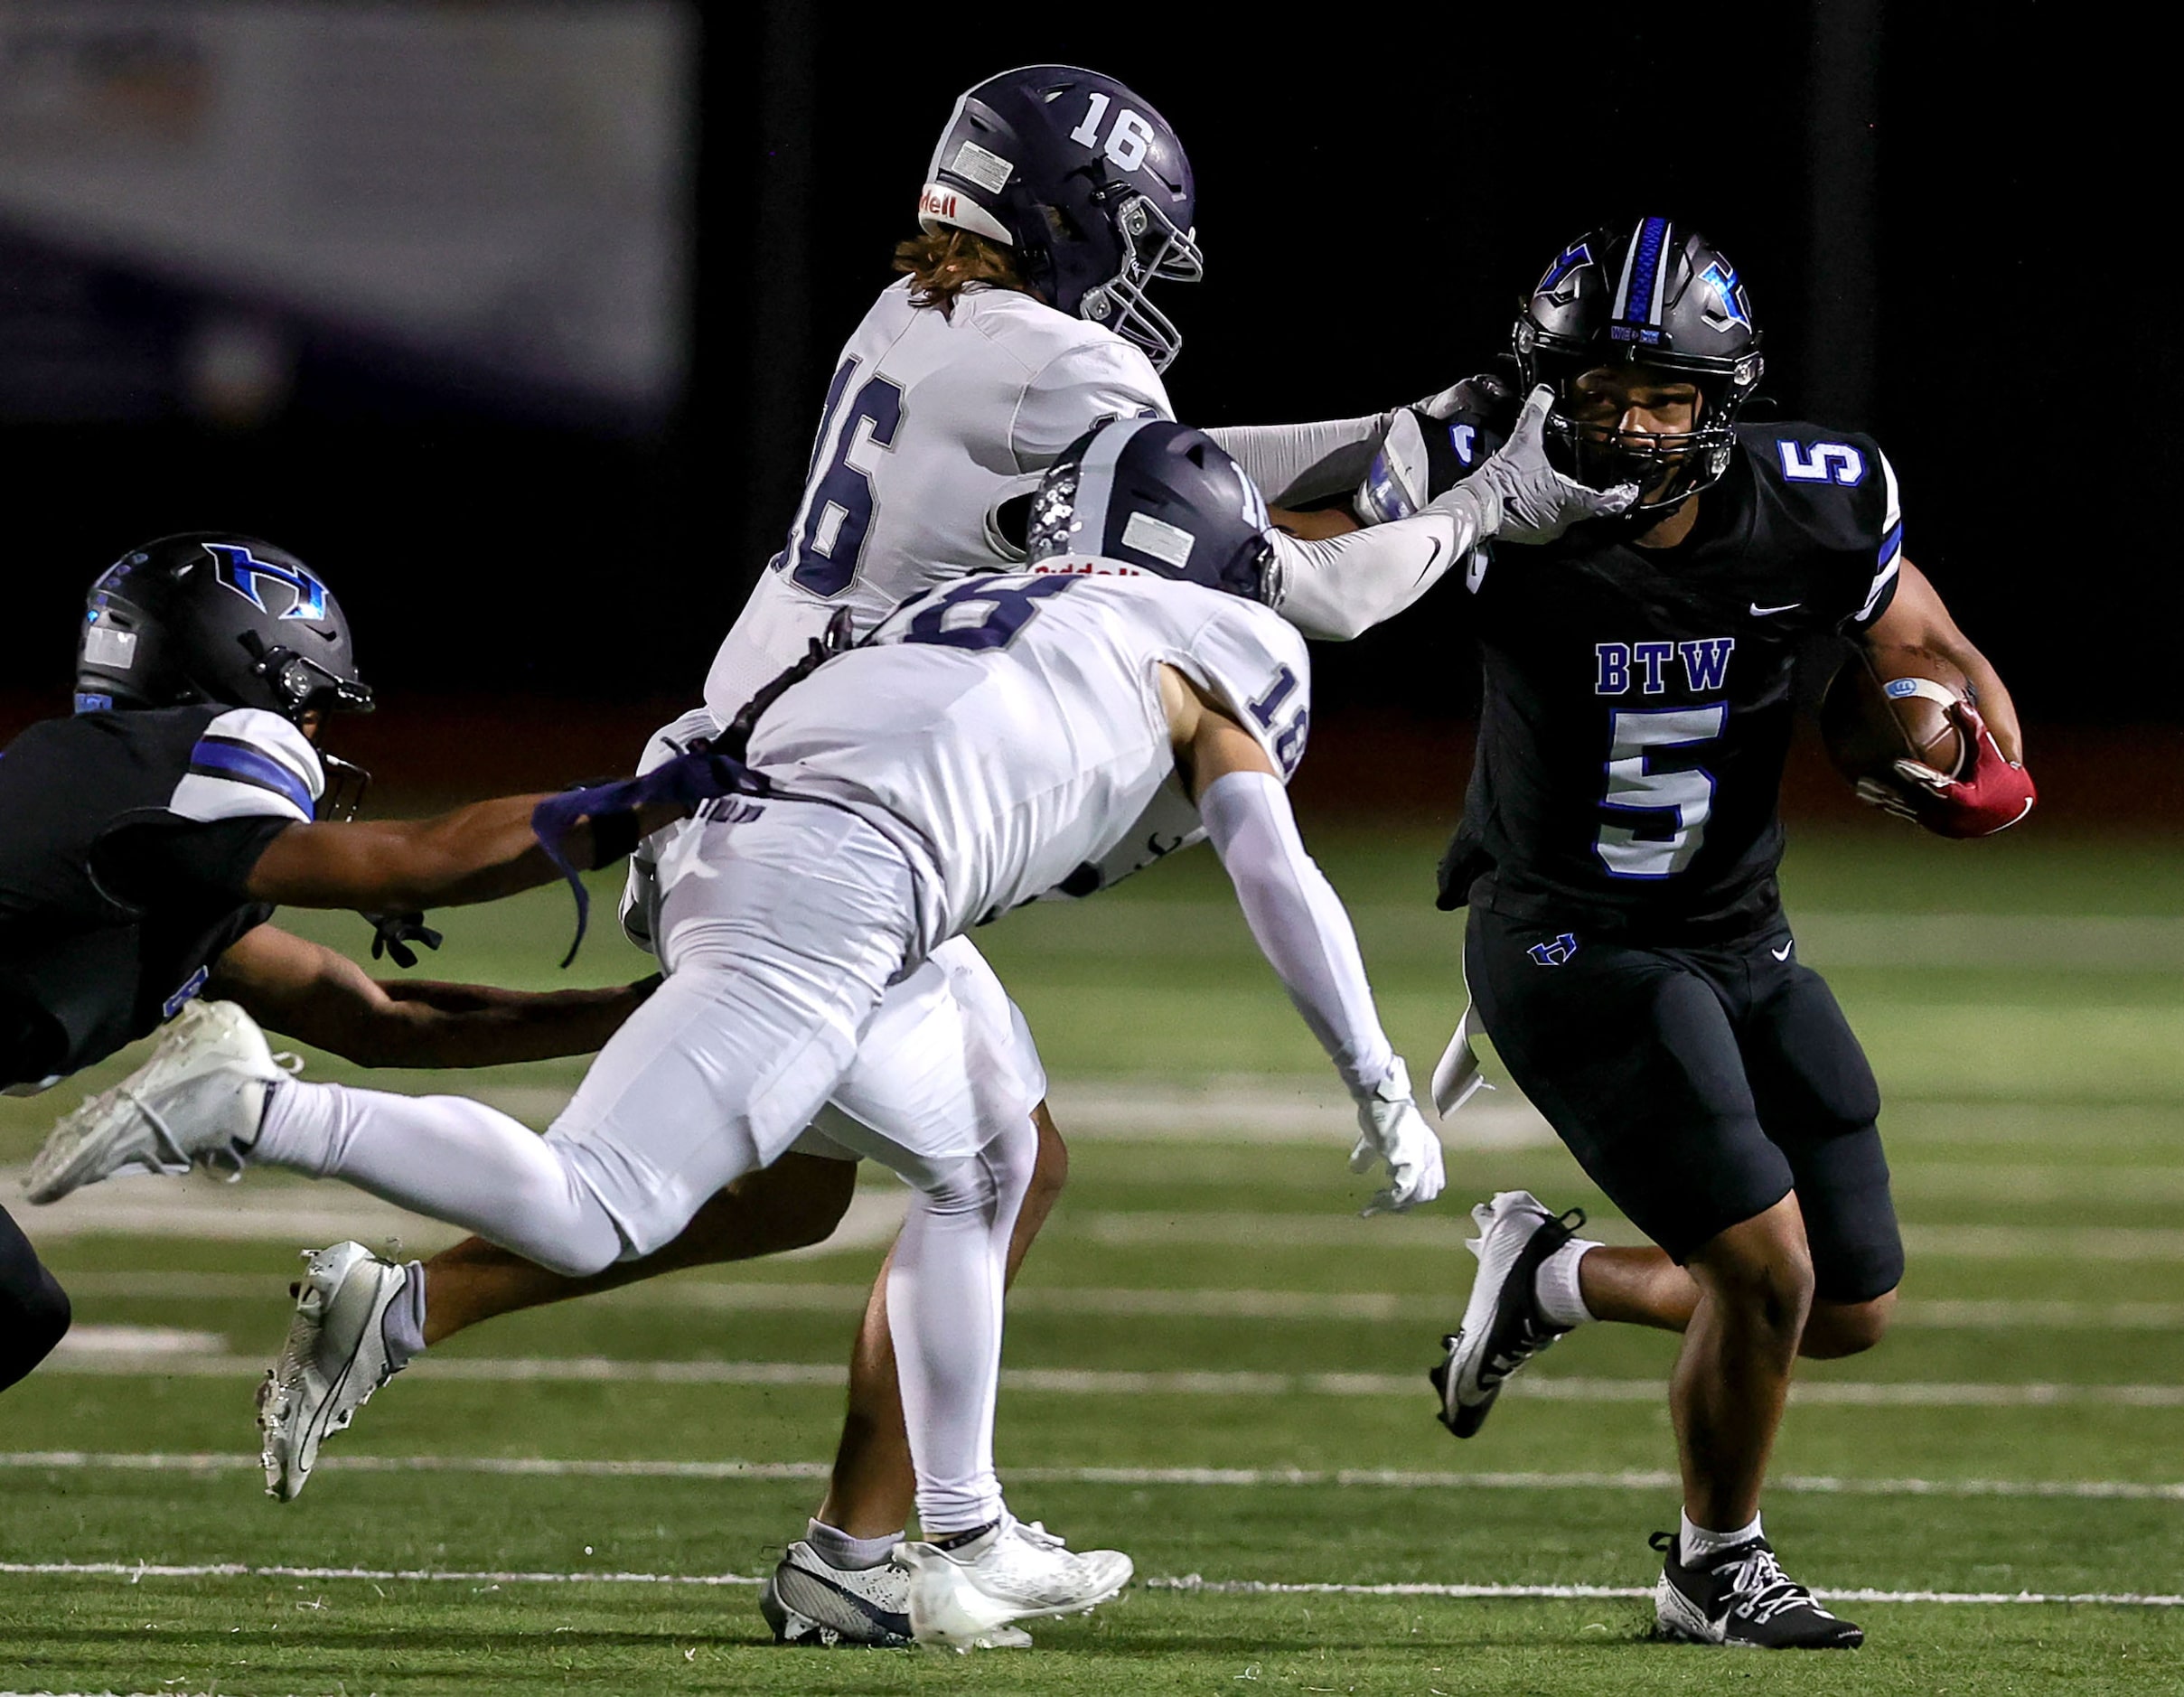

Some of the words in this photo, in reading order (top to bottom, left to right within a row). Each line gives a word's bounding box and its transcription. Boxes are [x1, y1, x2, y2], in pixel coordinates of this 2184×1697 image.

[1070, 92, 1154, 172] 16
[770, 352, 905, 600] 16
[1776, 439, 1866, 487] 5
[1595, 637, 1735, 695] BTW
[1591, 700, 1728, 880] 5
